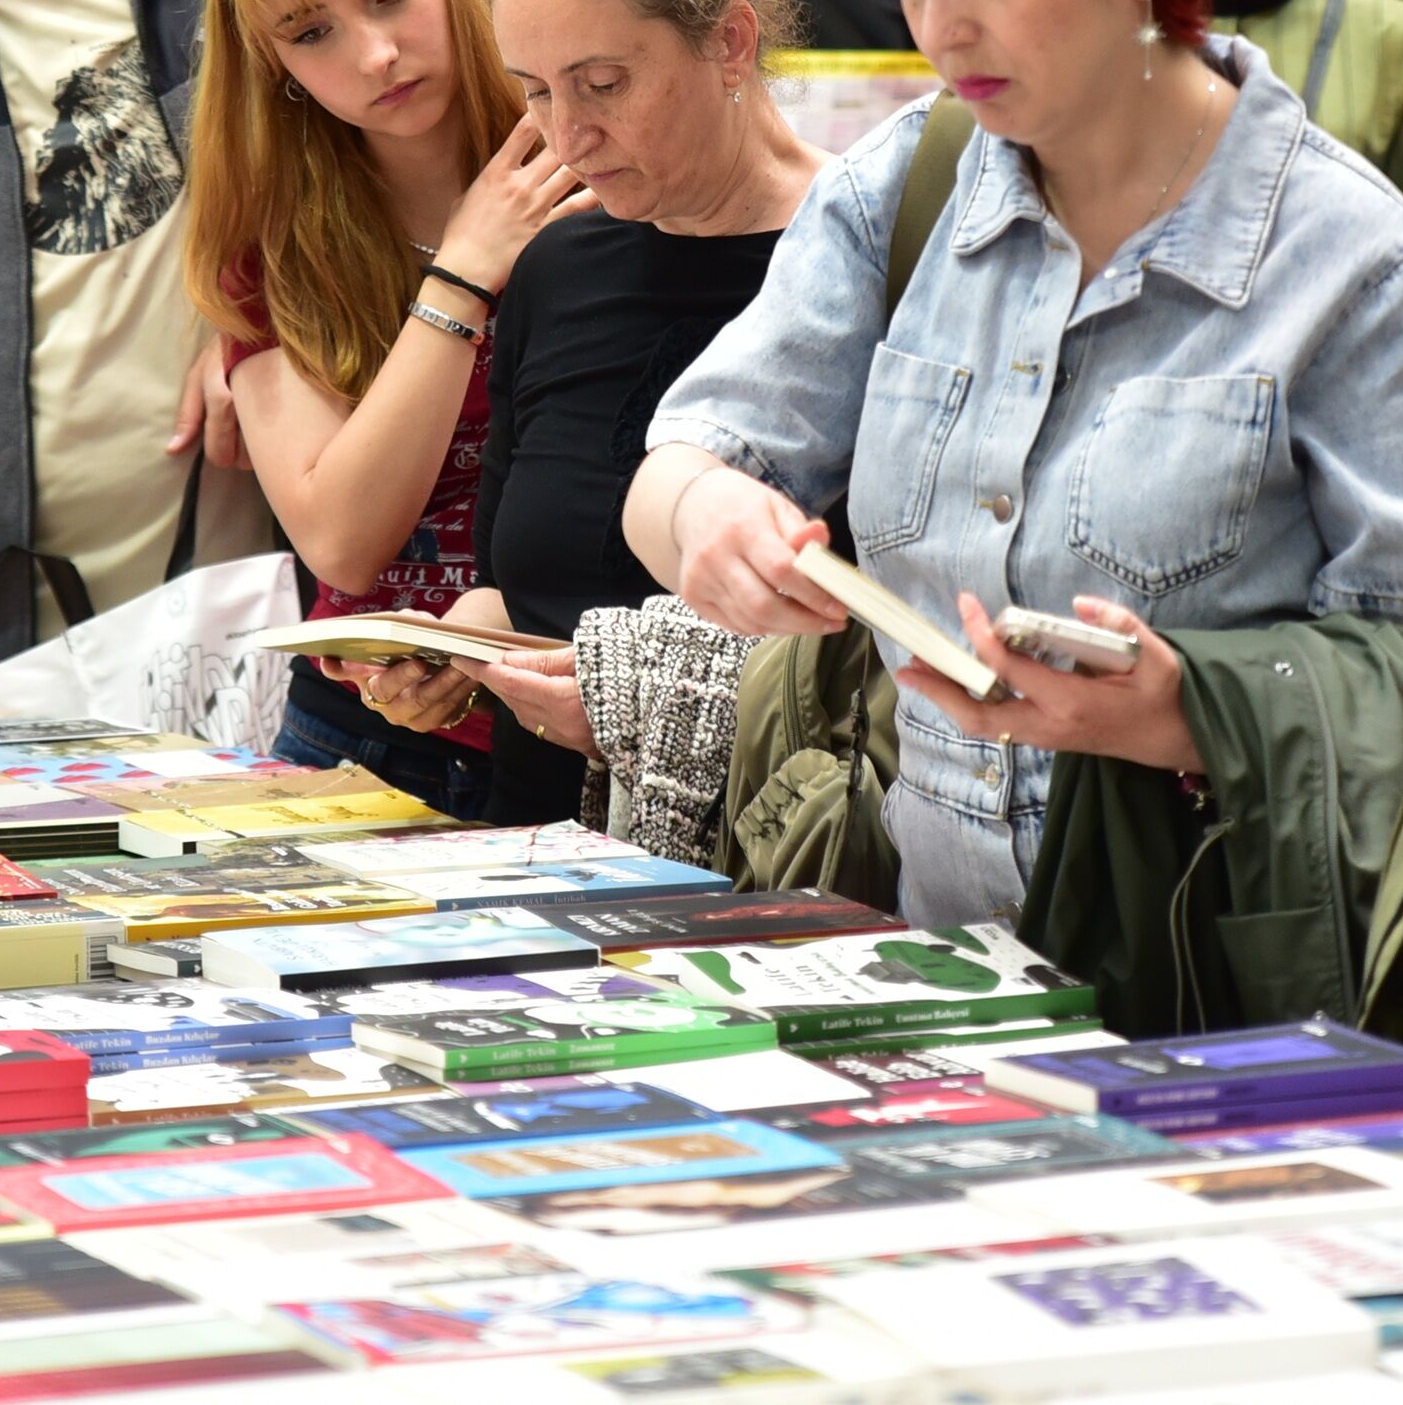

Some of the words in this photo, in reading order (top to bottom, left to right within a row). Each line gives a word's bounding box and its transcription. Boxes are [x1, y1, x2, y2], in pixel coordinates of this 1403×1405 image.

[821, 1017, 853, 1032] Latife
[854, 1015, 884, 1029] Tekin
[99, 1036, 132, 1049] Tekin
[526, 1044, 557, 1059] Tekin
